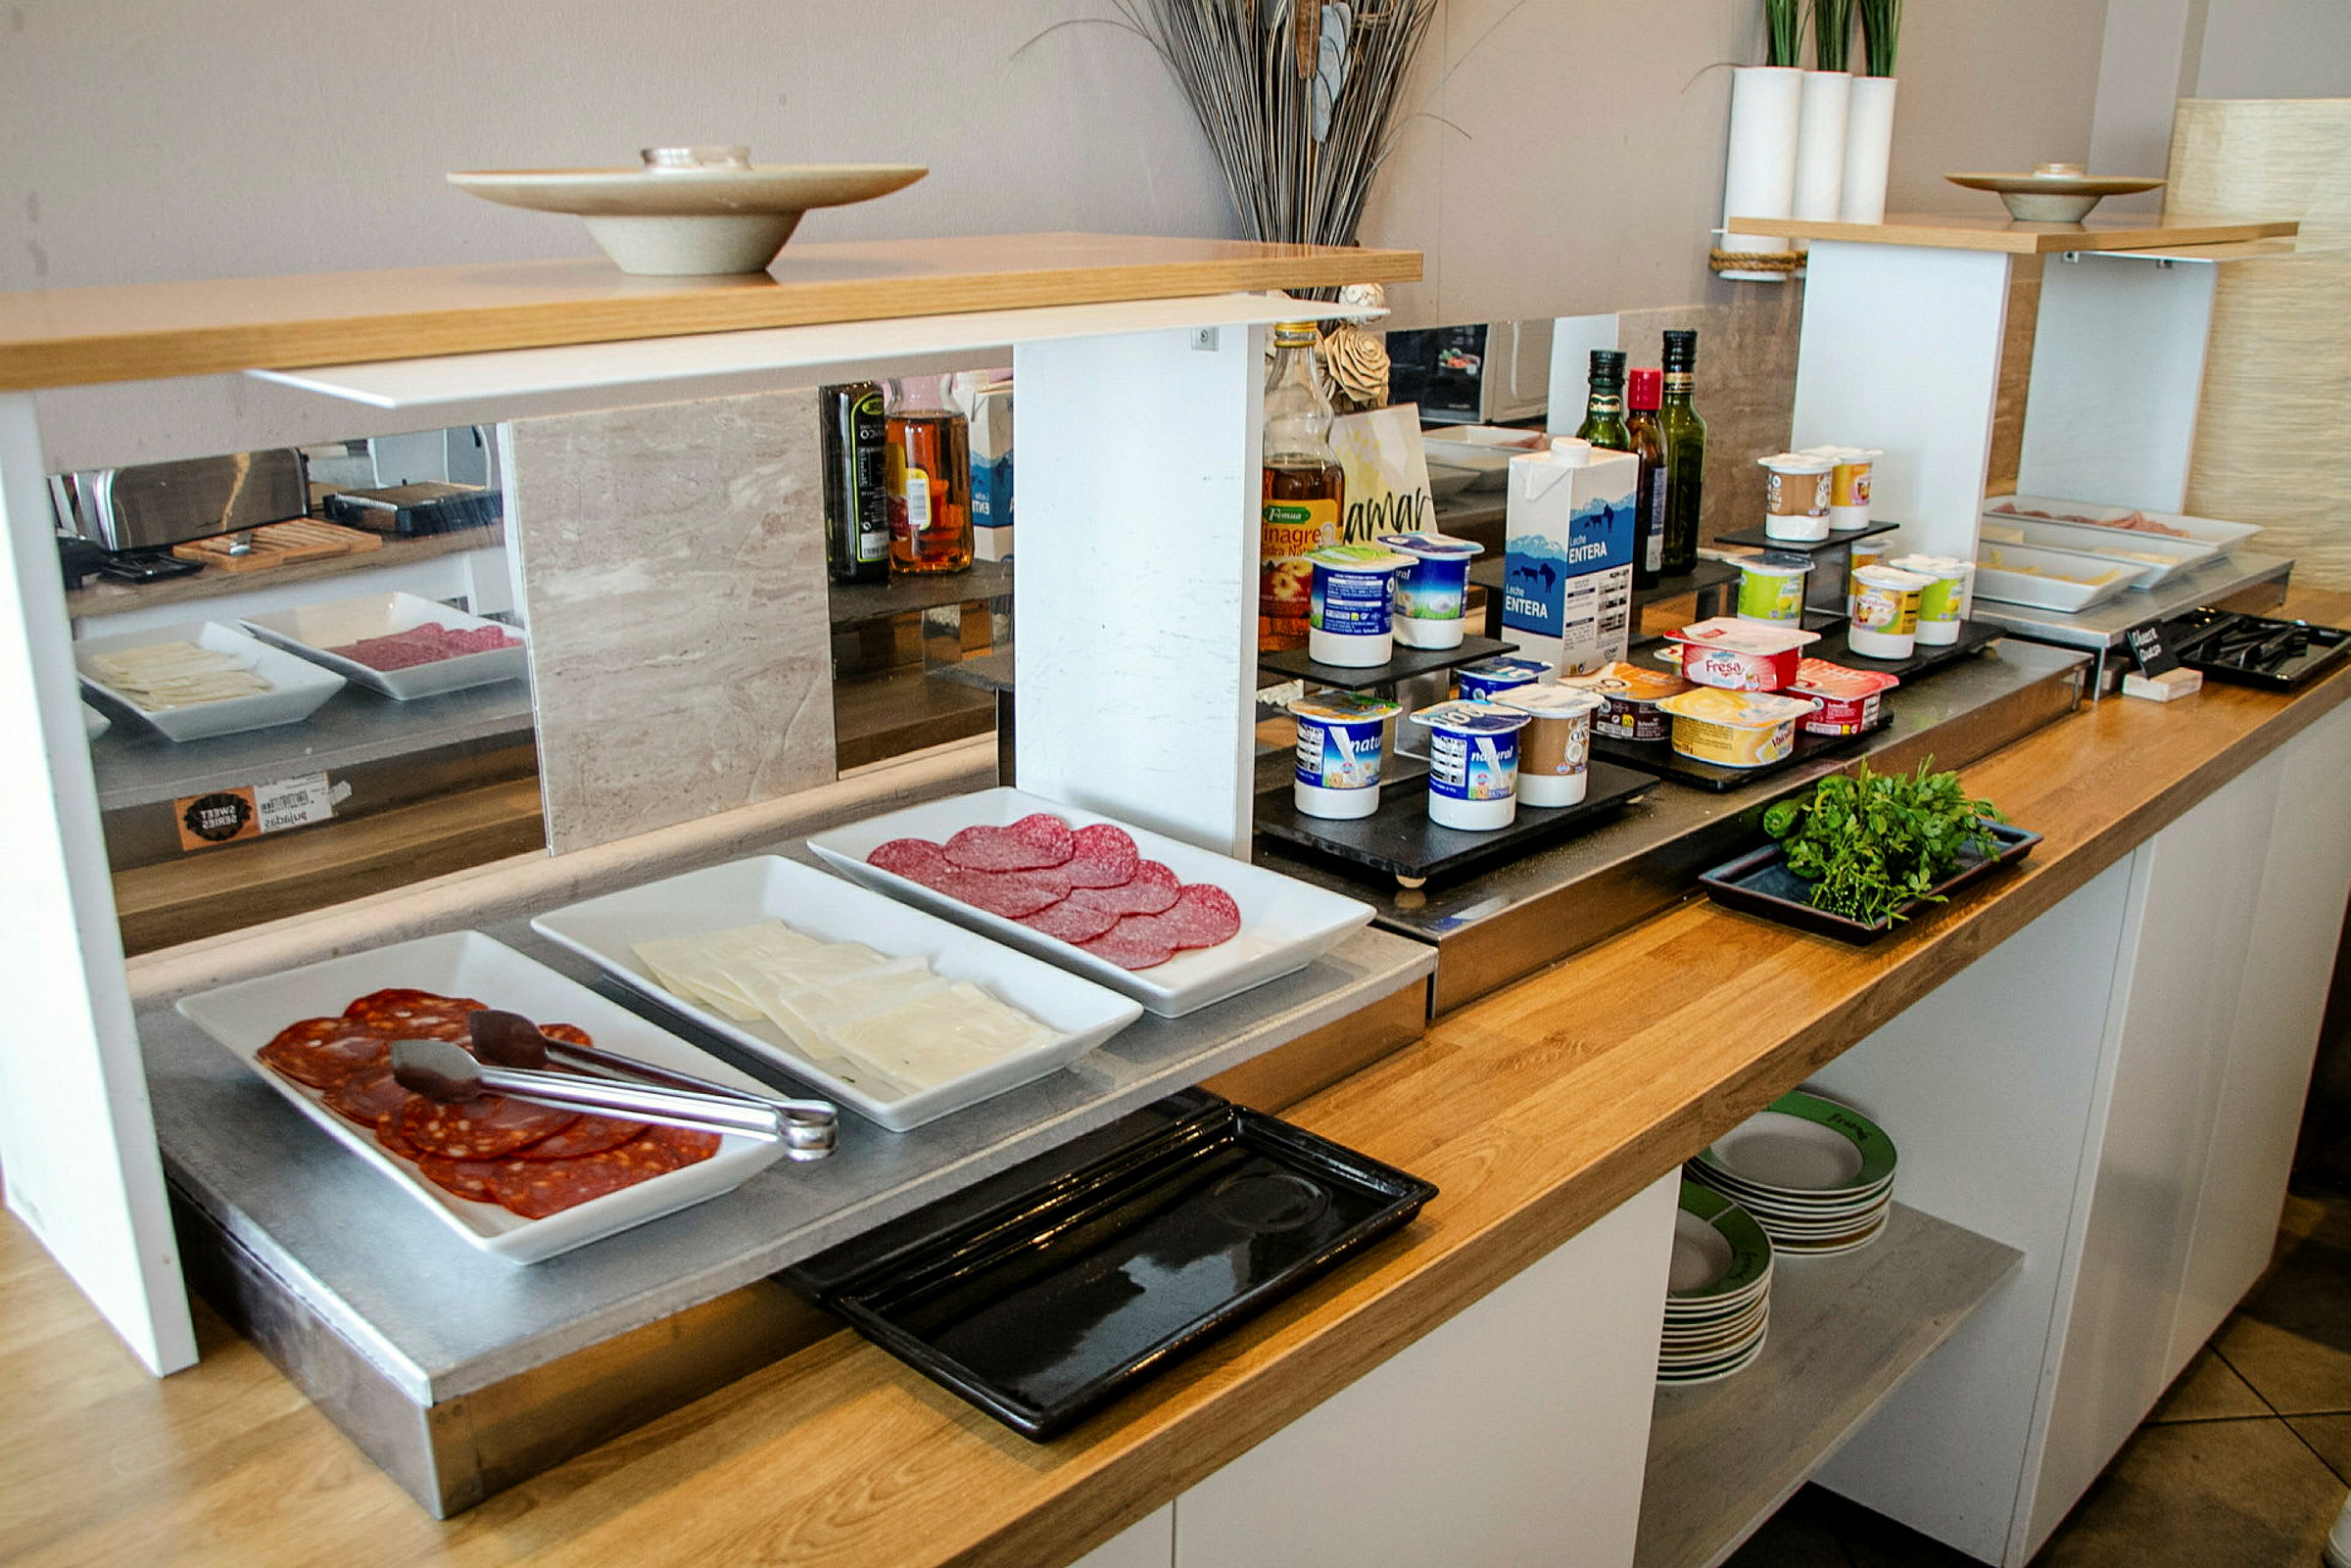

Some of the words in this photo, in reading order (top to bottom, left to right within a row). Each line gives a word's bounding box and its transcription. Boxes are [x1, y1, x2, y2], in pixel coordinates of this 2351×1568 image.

[1263, 526, 1322, 546] inagre
[1570, 536, 1587, 546] Leche
[1568, 542, 1607, 564] ENTERA
[1506, 584, 1525, 597] Leche
[1505, 595, 1549, 619] ENTERA
[1705, 659, 1745, 676] Fresa
